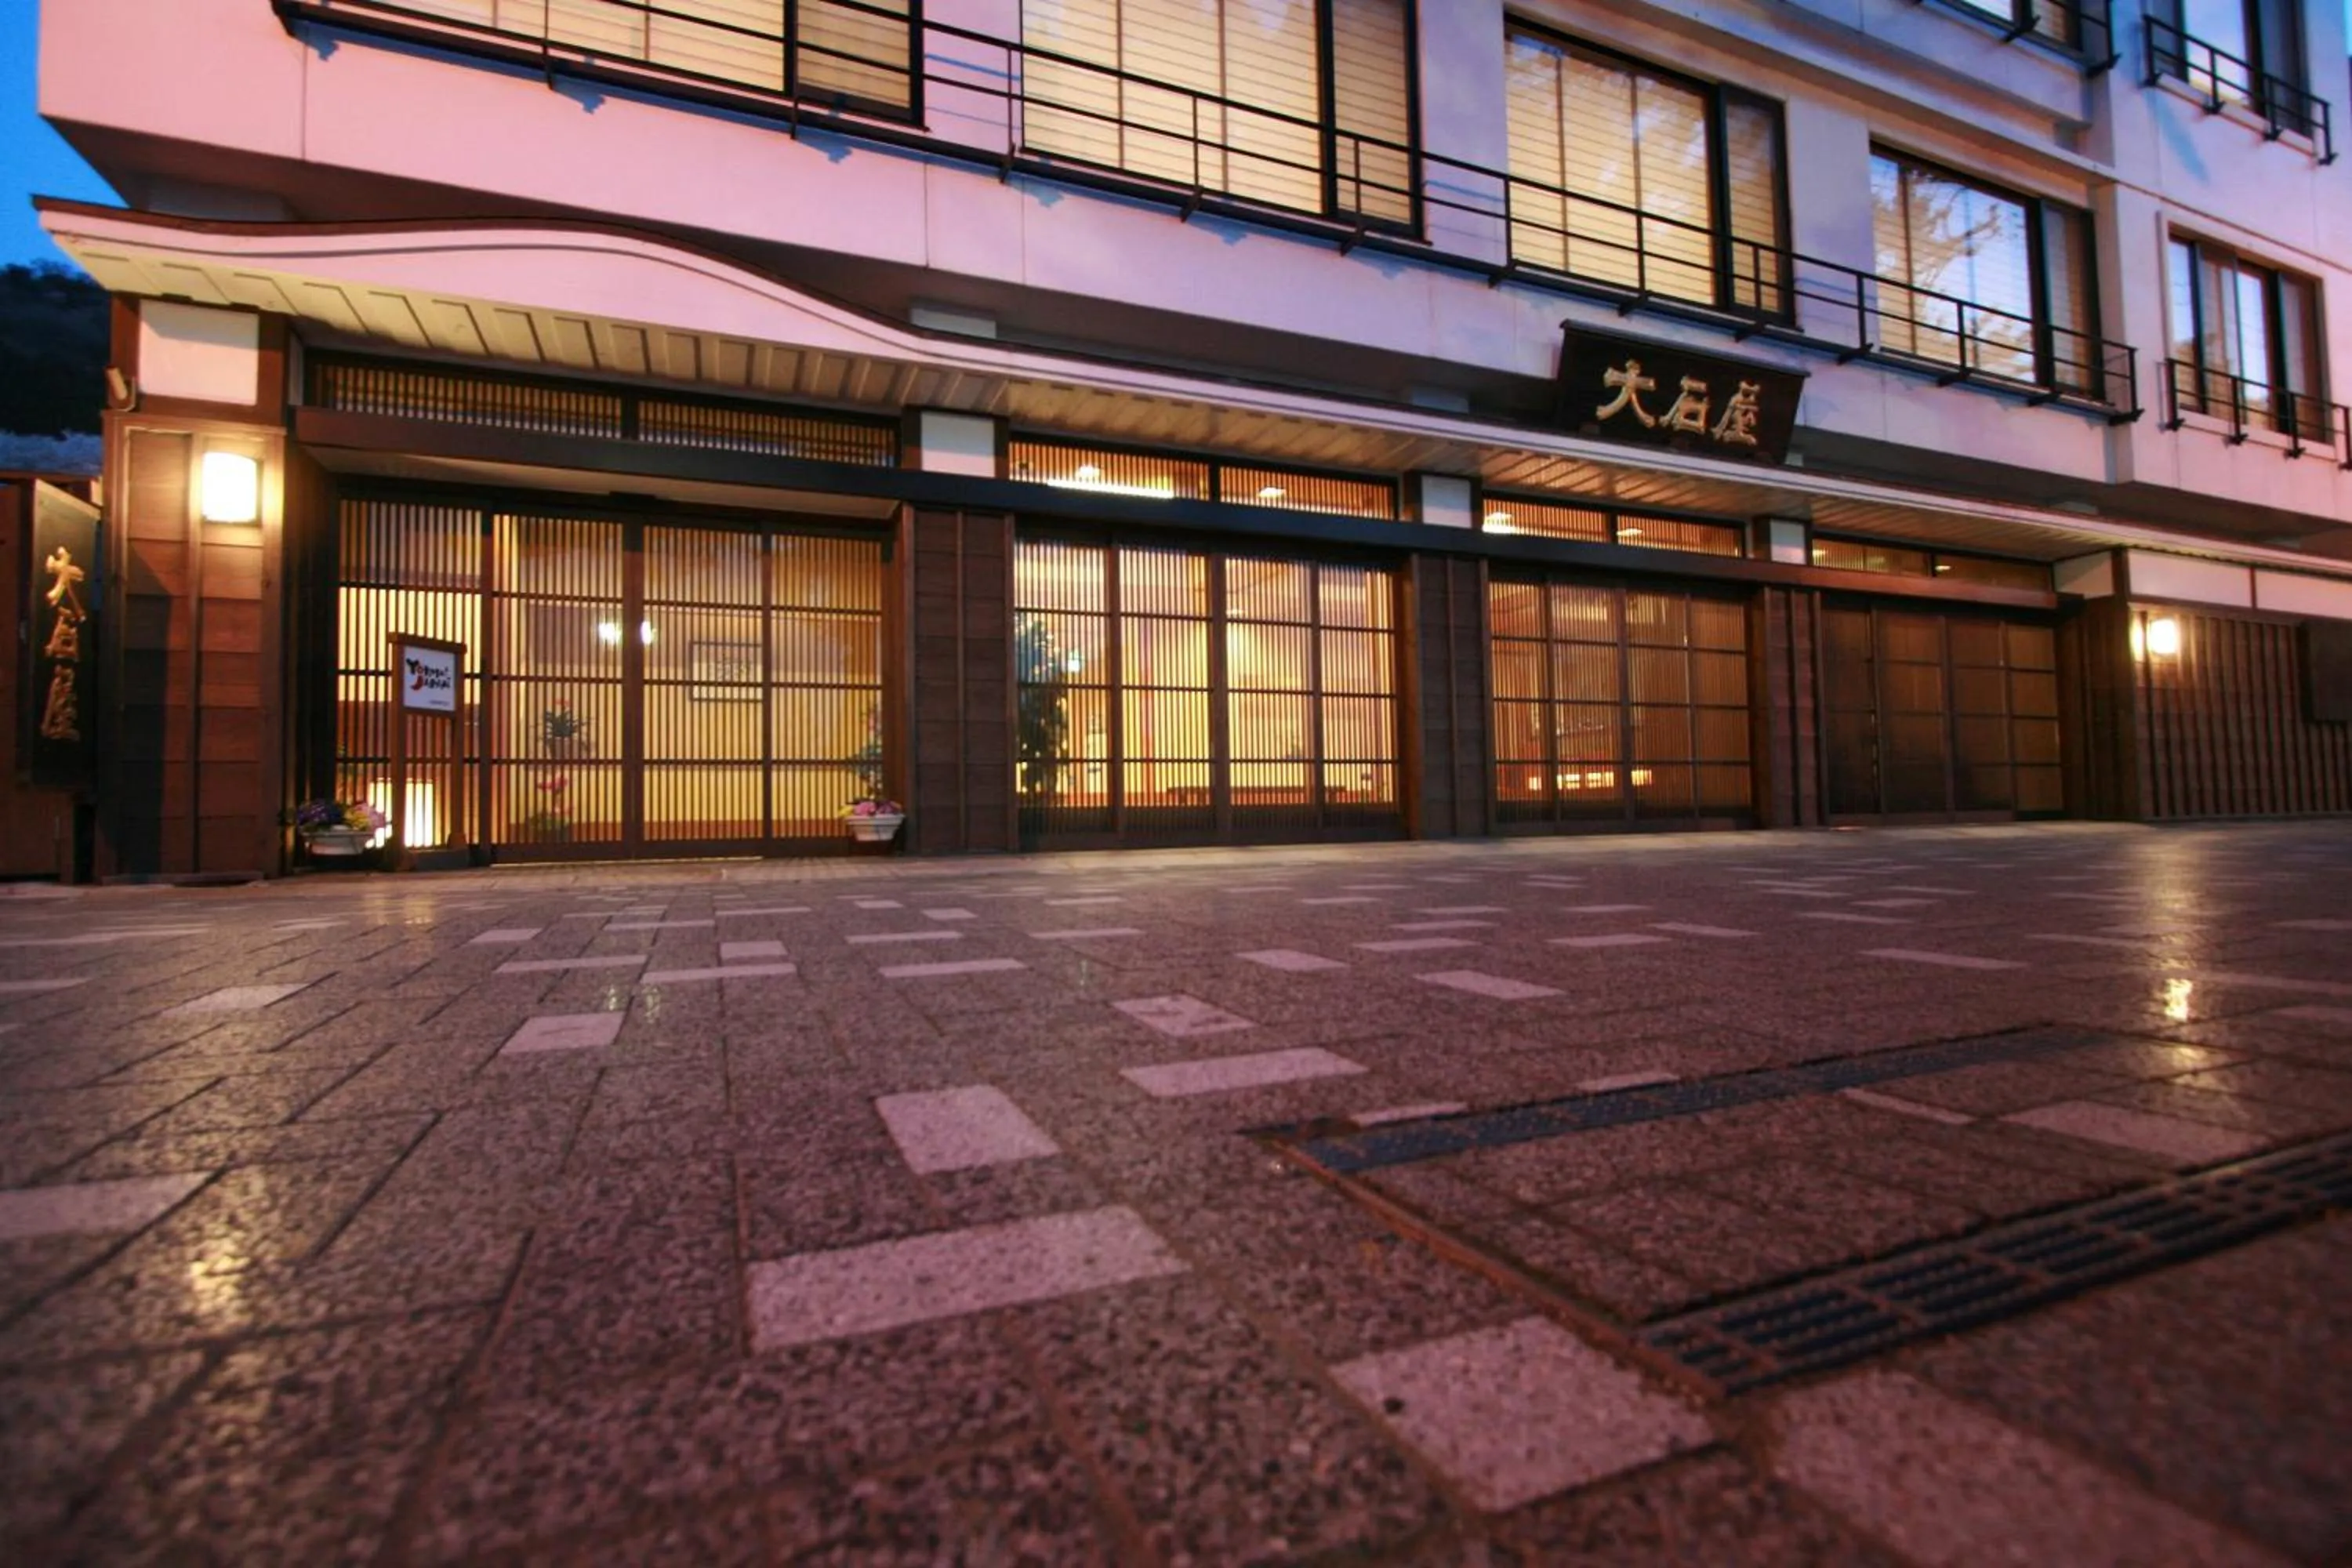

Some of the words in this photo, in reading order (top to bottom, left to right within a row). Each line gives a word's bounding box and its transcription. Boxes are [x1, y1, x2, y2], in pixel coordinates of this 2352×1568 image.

[1595, 358, 1760, 446] 大石屋
[41, 546, 86, 740] 大石屋
